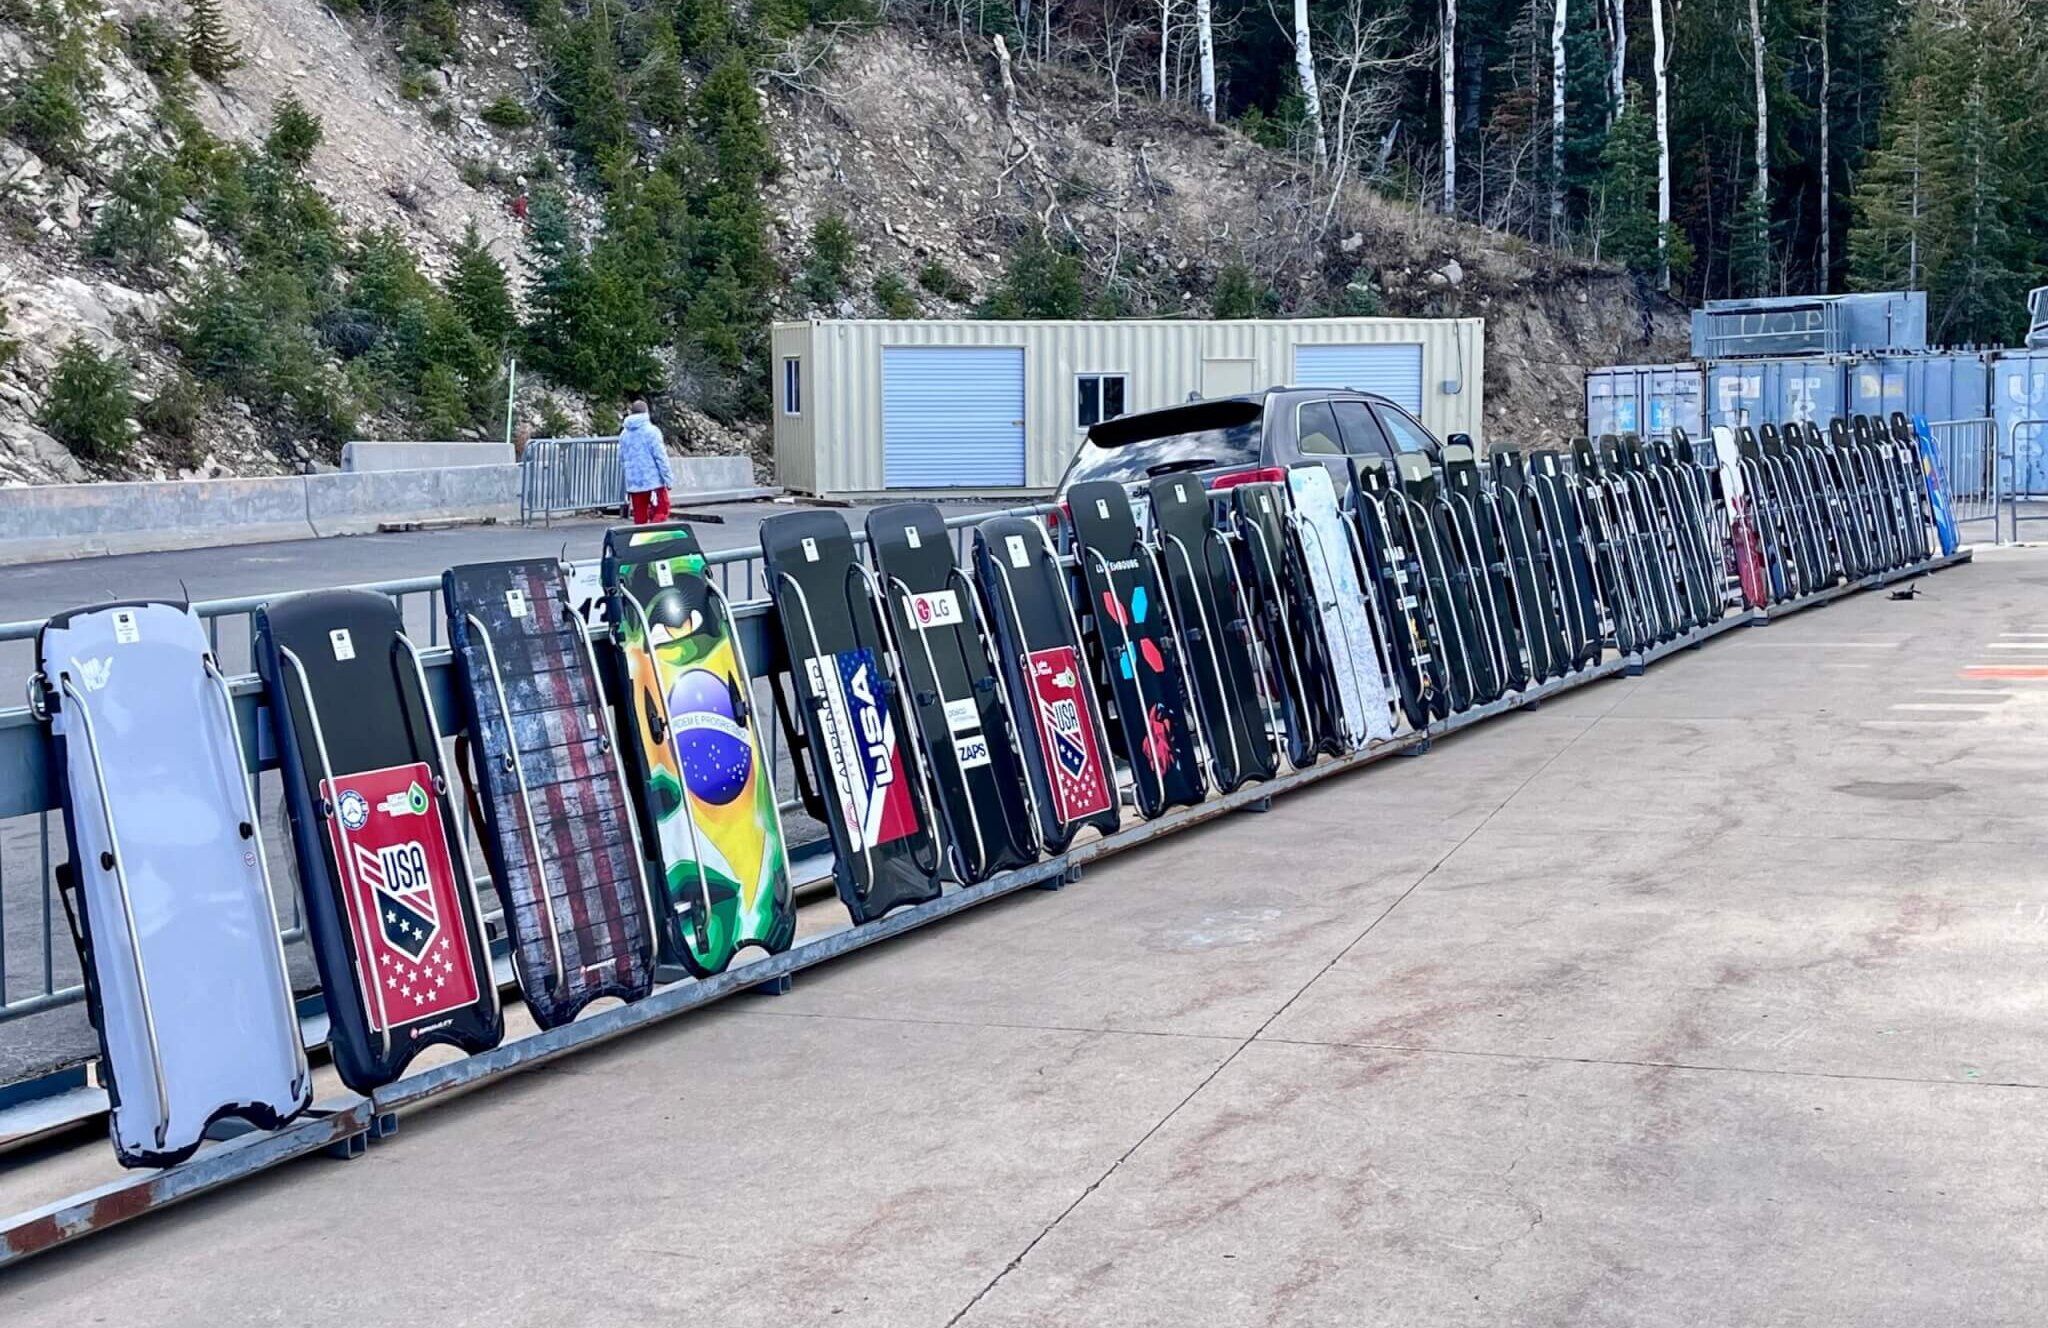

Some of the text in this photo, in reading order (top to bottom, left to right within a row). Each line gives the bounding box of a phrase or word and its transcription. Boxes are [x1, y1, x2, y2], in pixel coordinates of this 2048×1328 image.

[931, 599, 951, 618] LG
[851, 662, 895, 789] USA
[1054, 702, 1078, 732] USA
[957, 743, 986, 761] ZAPS
[382, 846, 427, 892] USA
